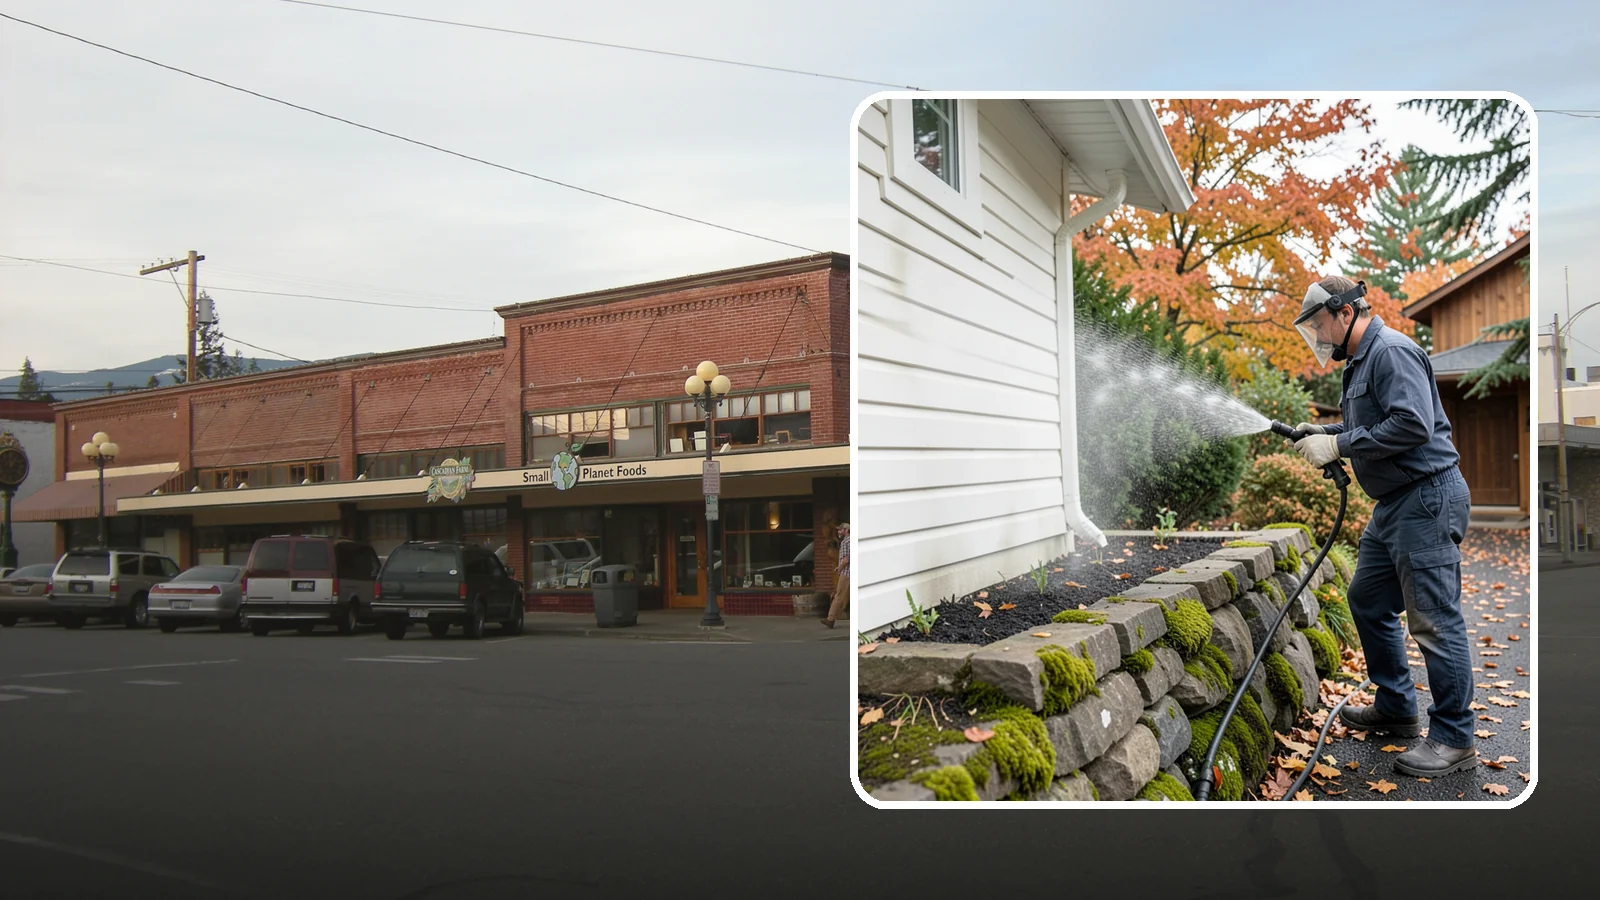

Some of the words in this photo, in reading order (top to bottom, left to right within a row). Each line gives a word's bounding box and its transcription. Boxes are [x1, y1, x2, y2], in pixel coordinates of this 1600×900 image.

[523, 471, 549, 483] Small
[583, 468, 614, 479] Planet
[617, 465, 647, 477] Foods
